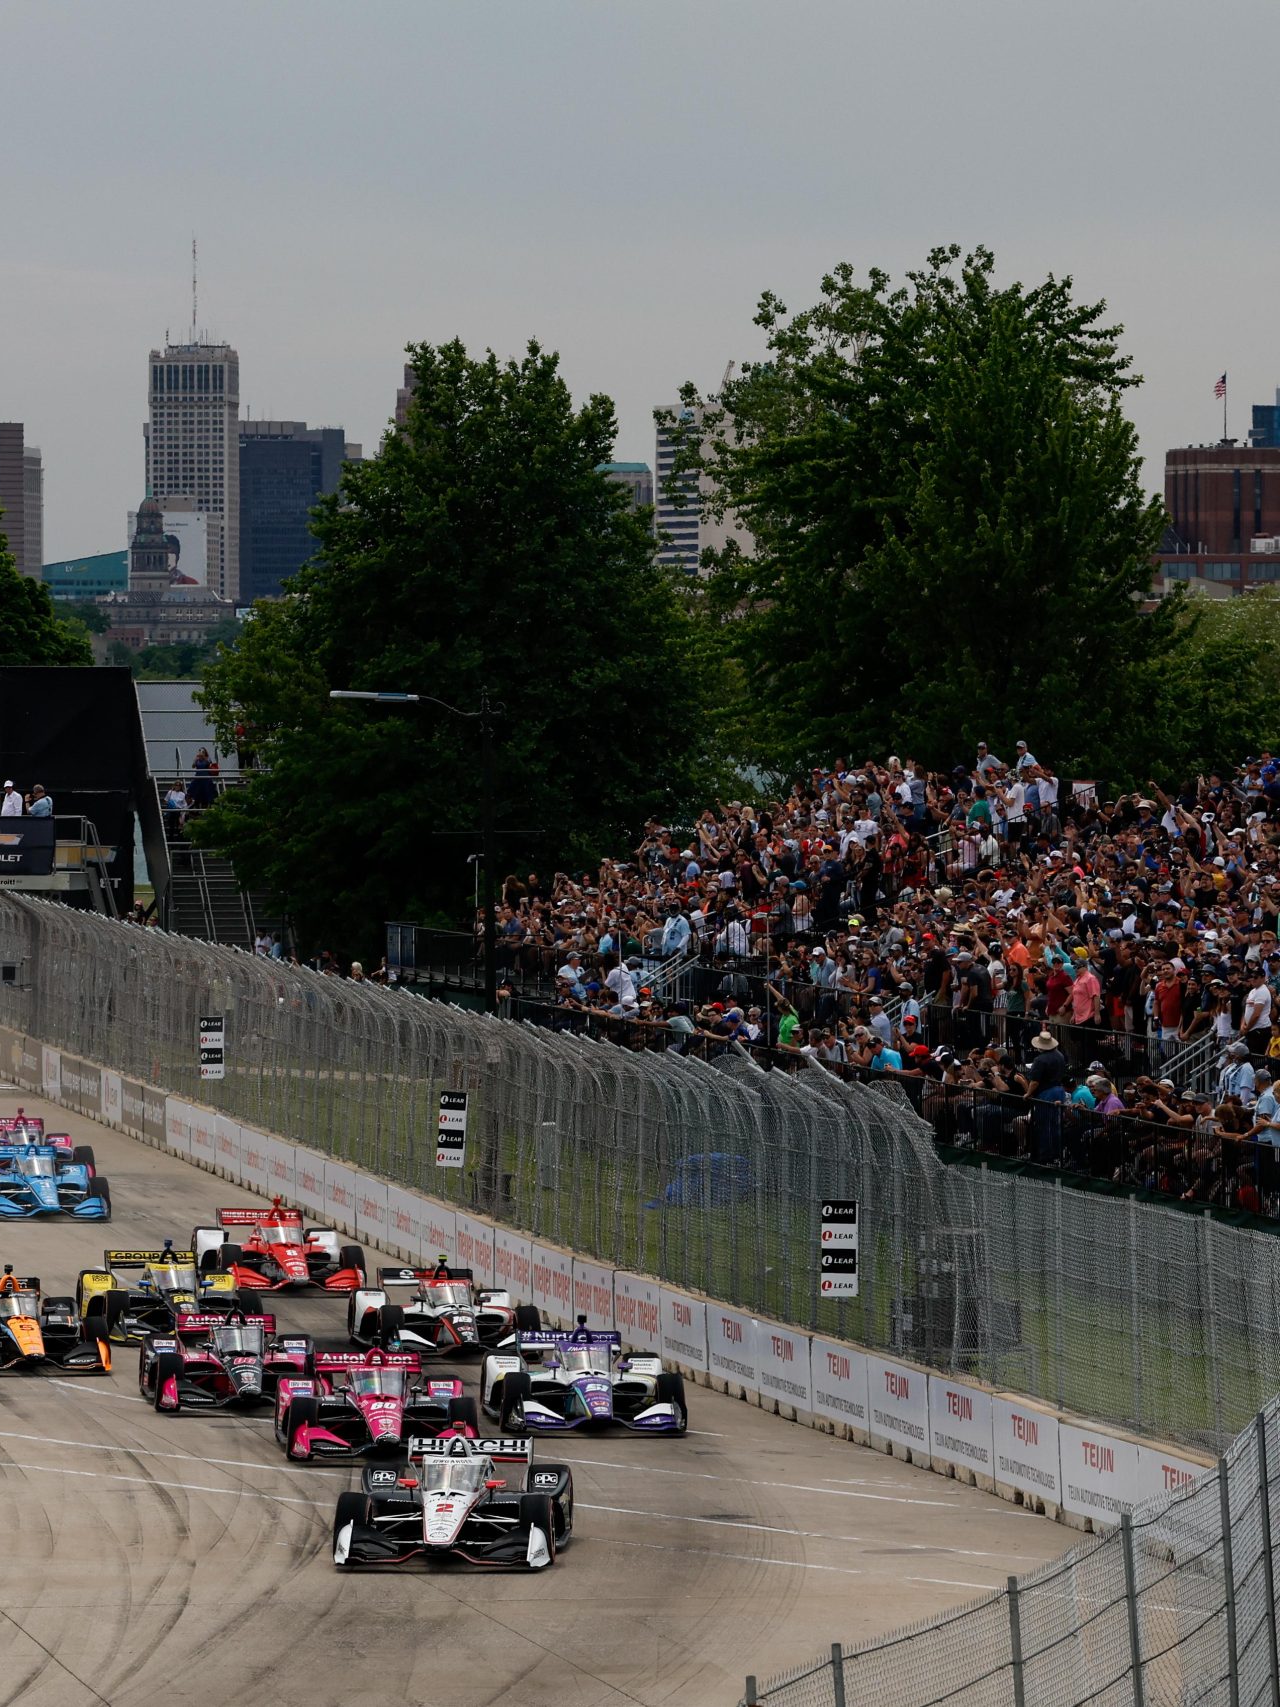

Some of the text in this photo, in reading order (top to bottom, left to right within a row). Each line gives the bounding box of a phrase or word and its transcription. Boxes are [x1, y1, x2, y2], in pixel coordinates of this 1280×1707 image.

[672, 1302, 692, 1327] TEIJIN
[722, 1318, 742, 1344] TEIJIN
[772, 1336, 793, 1362] TEIJIN
[827, 1352, 850, 1380] TEIJIN
[884, 1371, 909, 1400] TEIJIN
[946, 1392, 972, 1421] TEIJIN
[1012, 1414, 1038, 1446] TEIJIN
[1082, 1442, 1114, 1473] TEIJIN
[374, 1472, 396, 1482] PPG
[535, 1474, 557, 1485] PPG
[436, 1504, 454, 1512] 2
